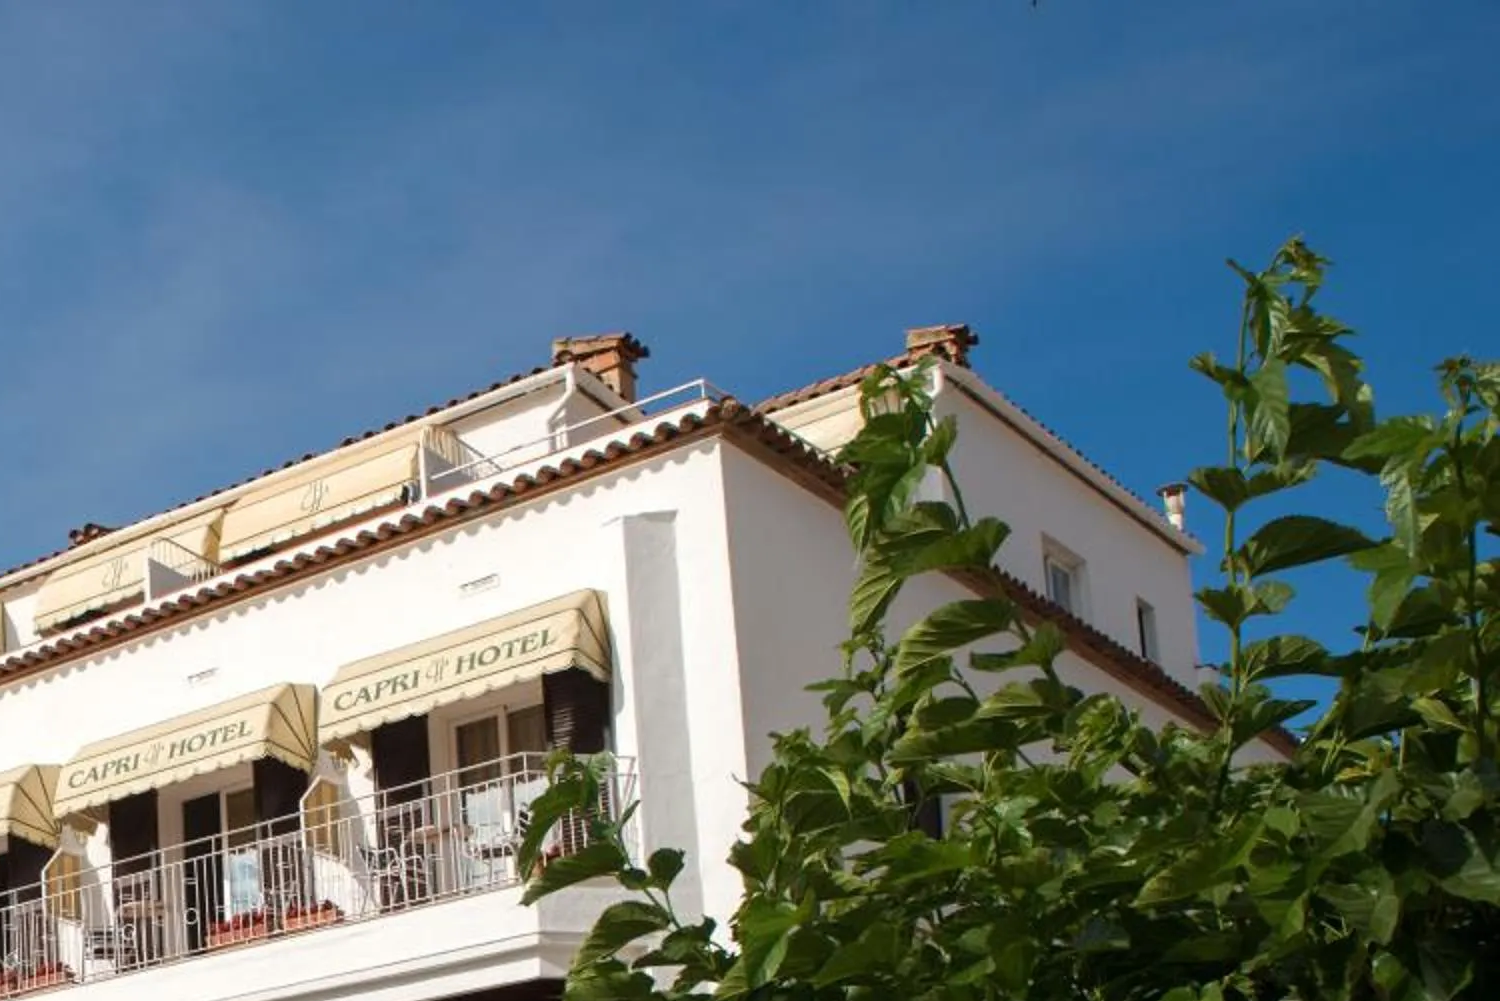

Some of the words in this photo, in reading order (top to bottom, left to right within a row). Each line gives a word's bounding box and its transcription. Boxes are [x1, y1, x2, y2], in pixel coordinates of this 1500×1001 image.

[334, 670, 420, 712] CAPRI
[454, 628, 557, 676] HOTEL
[67, 752, 140, 789] CAPRI
[168, 719, 253, 760] HOTEL
